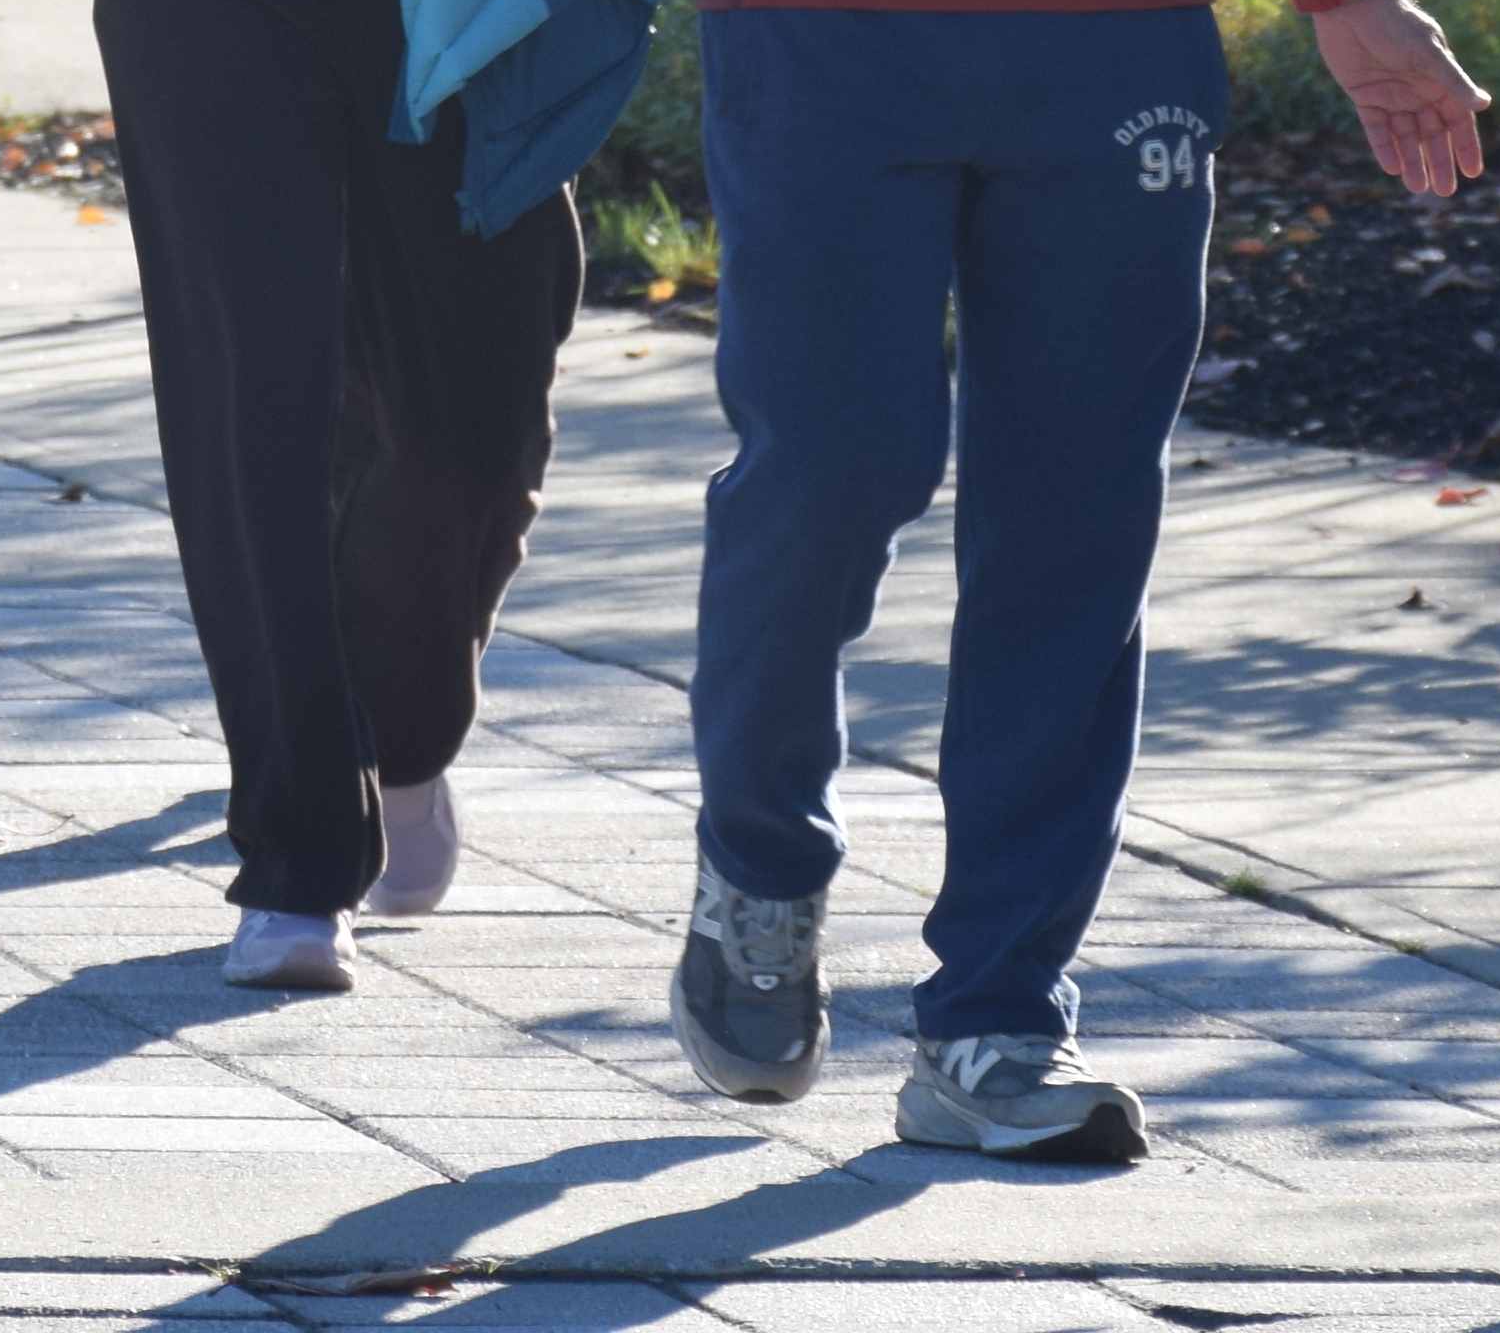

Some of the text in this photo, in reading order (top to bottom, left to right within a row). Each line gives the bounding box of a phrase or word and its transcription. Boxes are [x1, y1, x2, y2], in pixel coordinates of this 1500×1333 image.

[1114, 106, 1209, 146] OLD NAVY
[1139, 135, 1196, 191] 94
